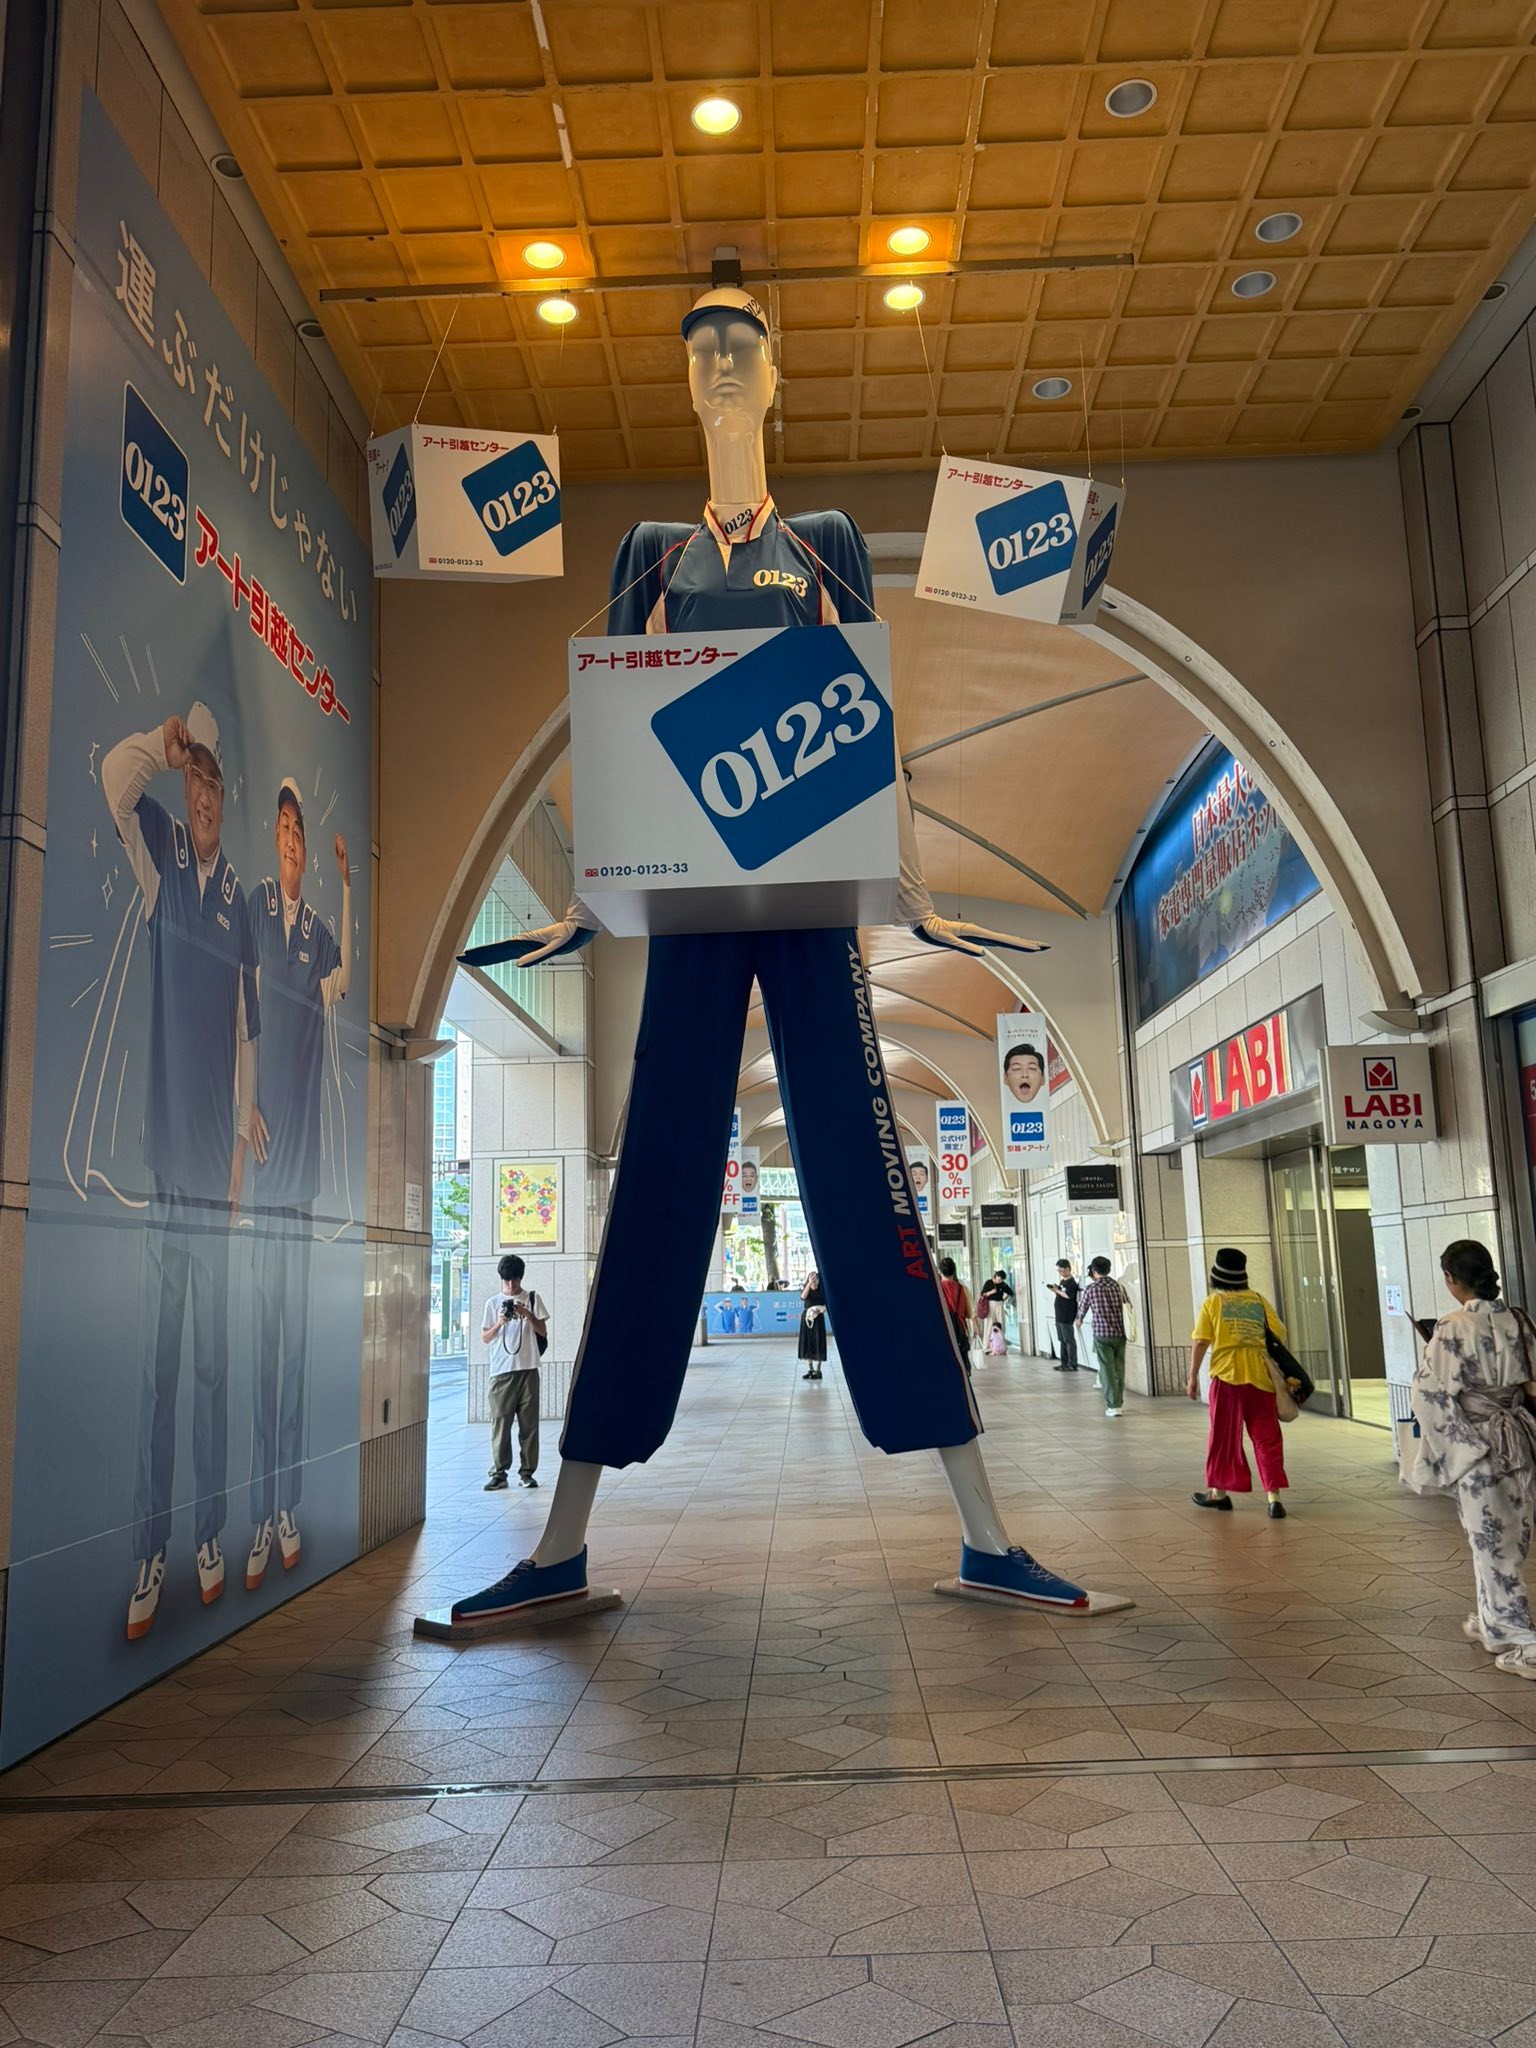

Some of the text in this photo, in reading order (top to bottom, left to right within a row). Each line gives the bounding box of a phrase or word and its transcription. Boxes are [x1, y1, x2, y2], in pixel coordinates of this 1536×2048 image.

[742, 299, 762, 316] 012
[117, 220, 357, 622] 運ぶだけじゃない
[423, 437, 509, 453] アート引越センター
[947, 469, 1034, 490] アート引越センター
[125, 441, 185, 541] 0123
[482, 470, 556, 532] 0123
[390, 470, 413, 536] 0123
[724, 508, 754, 535] 0123
[988, 513, 1073, 570] 0123
[438, 558, 483, 566] 0120-0123-33
[1085, 530, 1114, 588] 0123
[753, 569, 808, 597] 0123
[933, 588, 977, 602] 0120-0123-33
[195, 505, 350, 724] アート引越センター
[577, 646, 738, 672] アート引越センター
[700, 672, 881, 818] 0123
[600, 863, 688, 877] 0120-0123-33
[1206, 1011, 1291, 1121] LABI
[847, 941, 929, 1280] ART MOVING COMPANY
[1344, 1094, 1422, 1117] LABI
[940, 1115, 965, 1125] 0123
[1012, 1121, 1043, 1134] 0123
[1347, 1119, 1423, 1129] NAGOYA
[726, 1160, 739, 1178] 0
[941, 1153, 969, 1172] 30
[949, 1172, 963, 1186] %
[723, 1194, 741, 1206] FF
[942, 1187, 970, 1199] OFF
